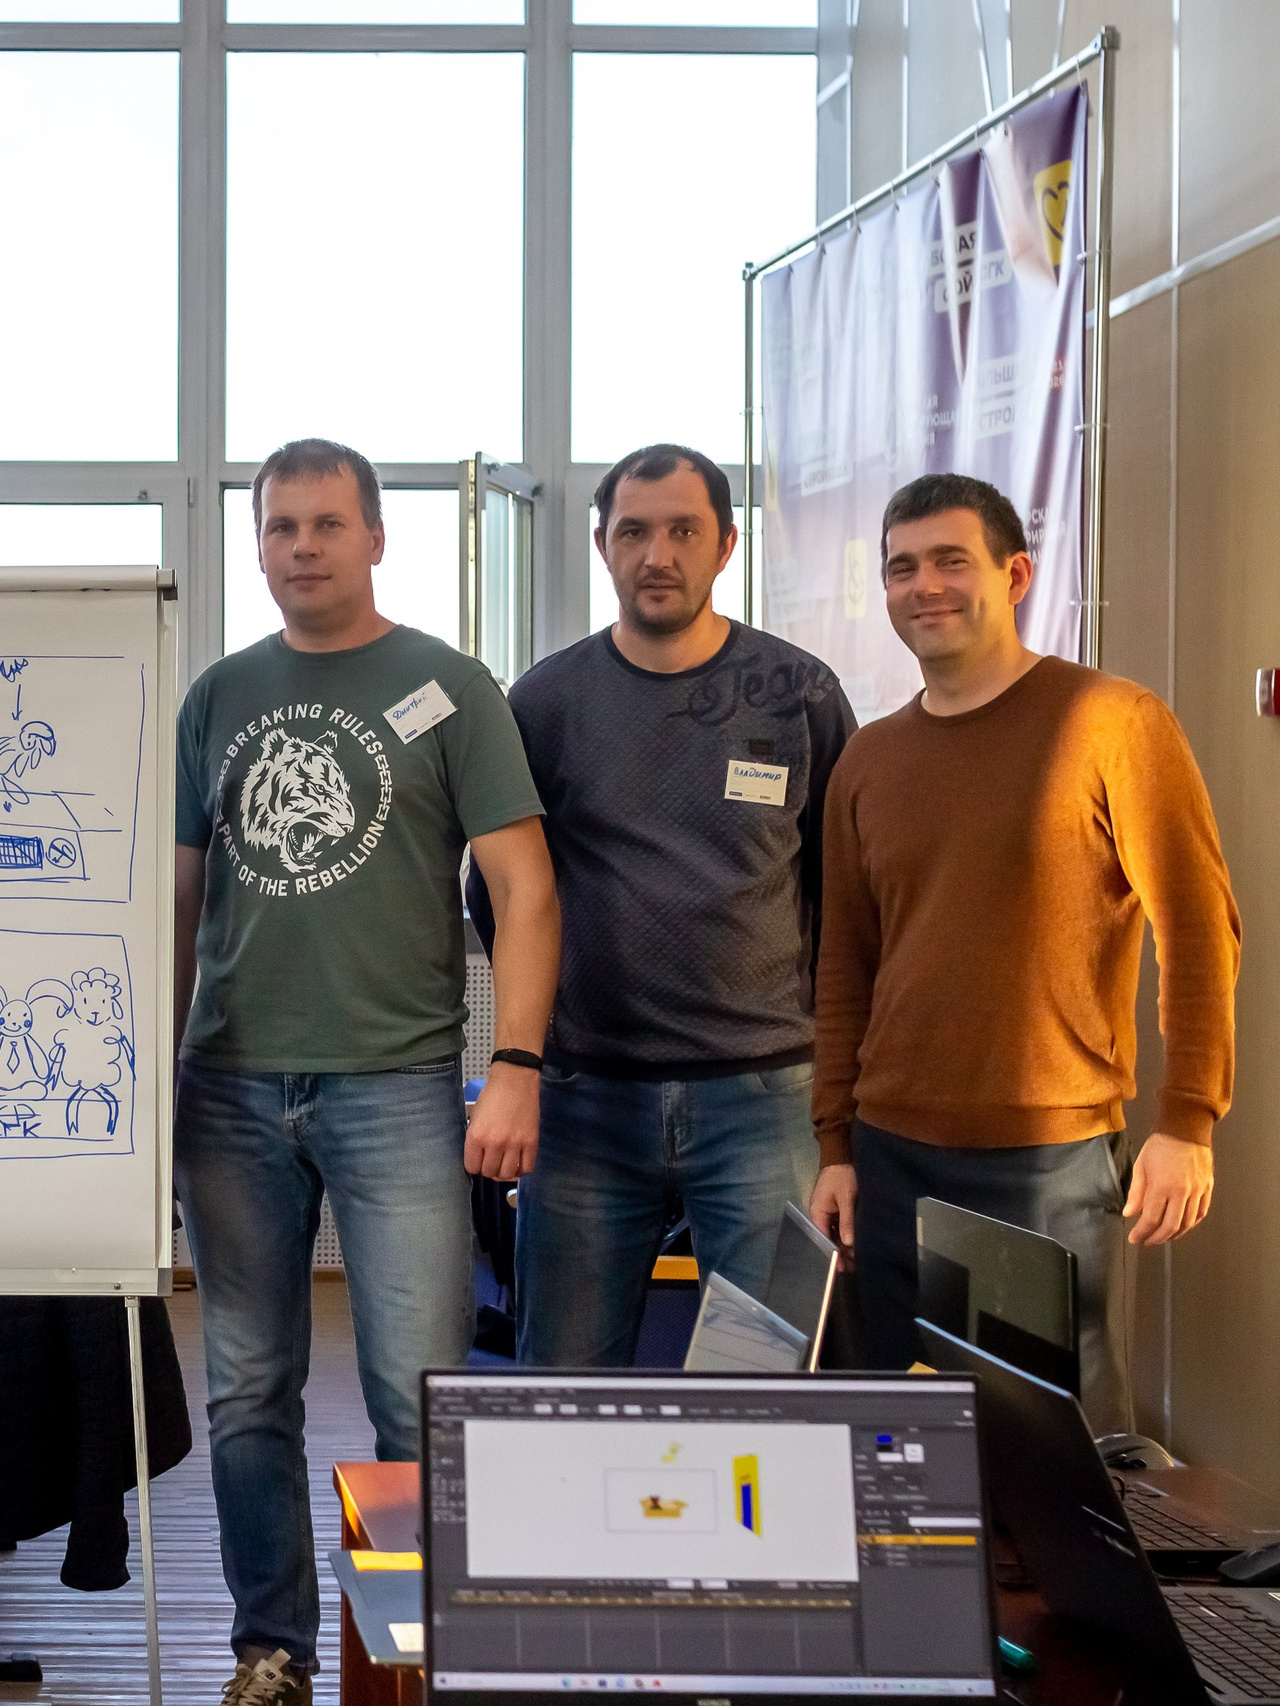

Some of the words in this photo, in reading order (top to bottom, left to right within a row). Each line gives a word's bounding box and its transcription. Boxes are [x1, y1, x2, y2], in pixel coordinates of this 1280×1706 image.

[225, 703, 323, 758] BREAKING
[328, 707, 384, 755] RULES
[217, 821, 241, 868] PART
[237, 864, 258, 887] OF
[259, 876, 289, 897] THE
[295, 820, 386, 895] REBELLION
